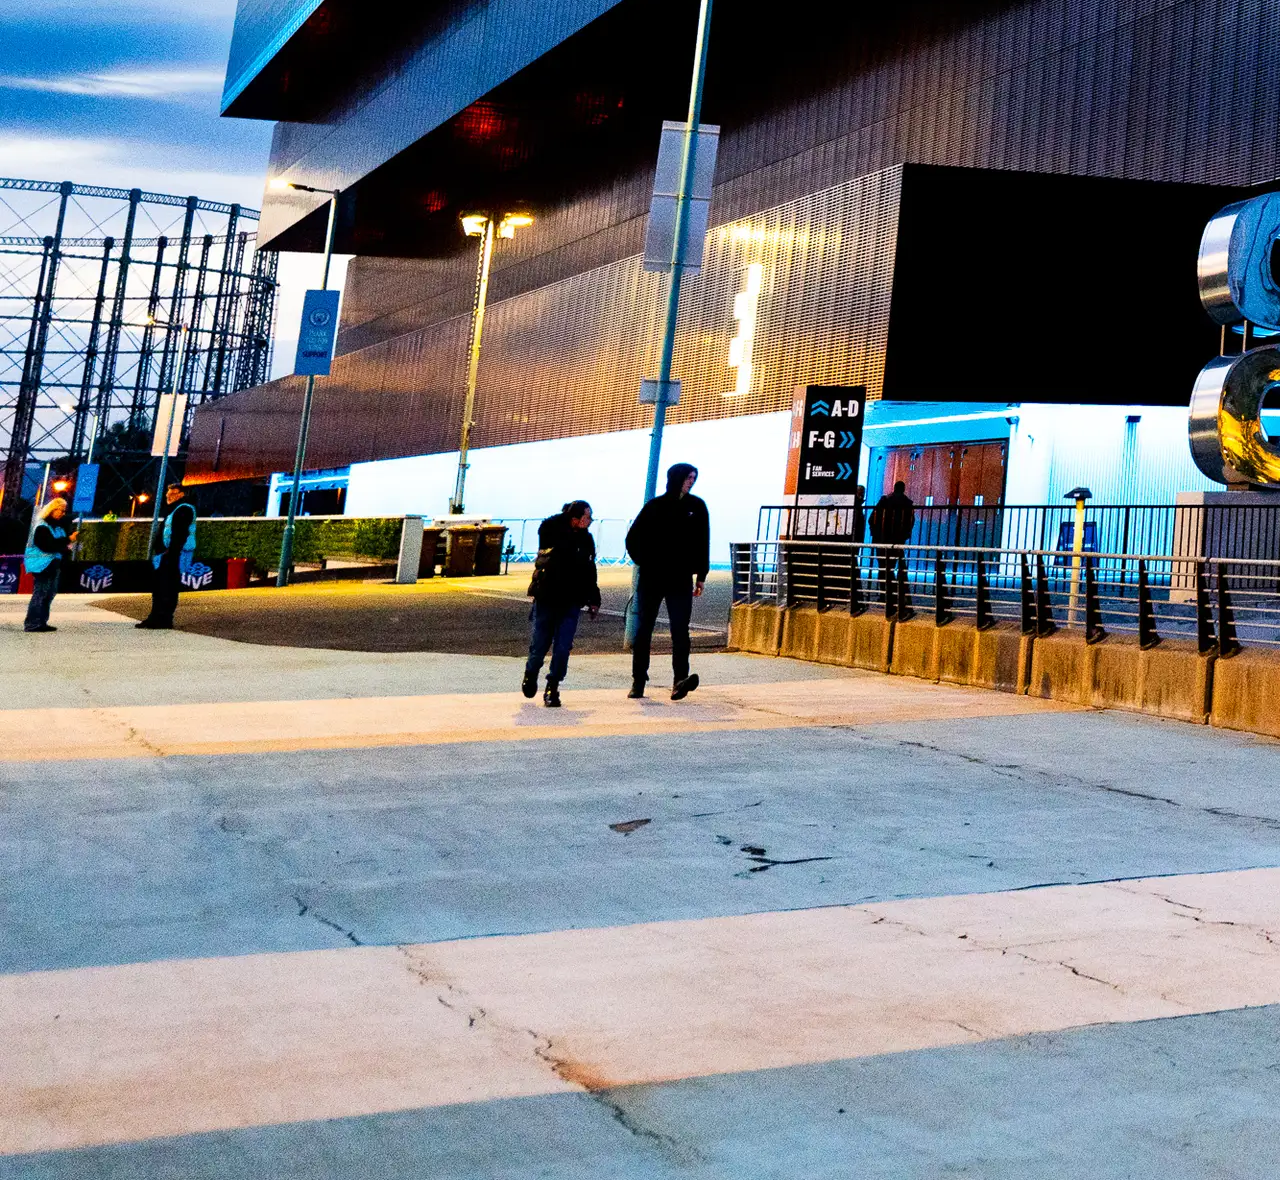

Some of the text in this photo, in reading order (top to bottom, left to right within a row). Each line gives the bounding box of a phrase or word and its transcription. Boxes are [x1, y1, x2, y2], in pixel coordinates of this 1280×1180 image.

[830, 399, 859, 417] A-D
[808, 430, 835, 448] F-G
[80, 573, 114, 592] LIVE
[180, 570, 214, 590] LIVE
